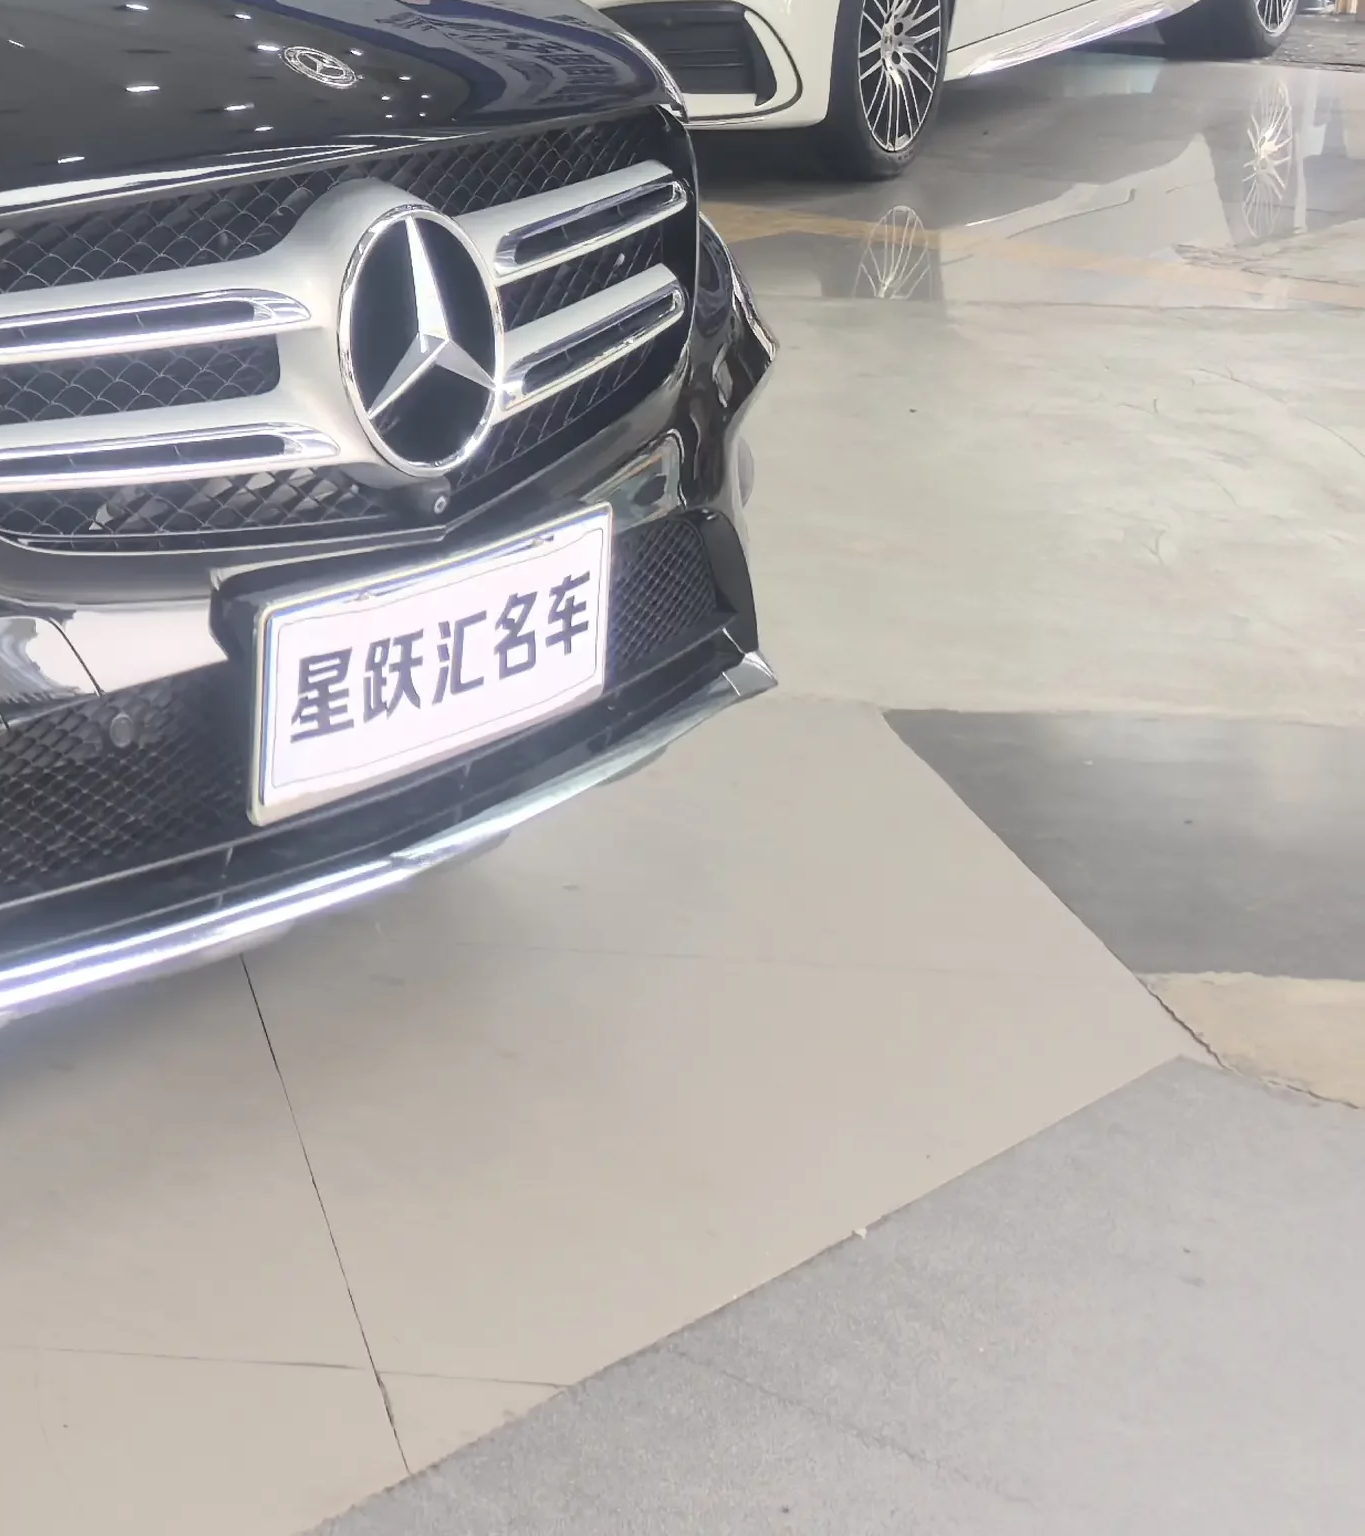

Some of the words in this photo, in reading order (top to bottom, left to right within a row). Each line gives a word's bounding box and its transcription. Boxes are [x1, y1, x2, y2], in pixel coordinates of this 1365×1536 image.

[290, 571, 590, 744] 星跃汇名车
